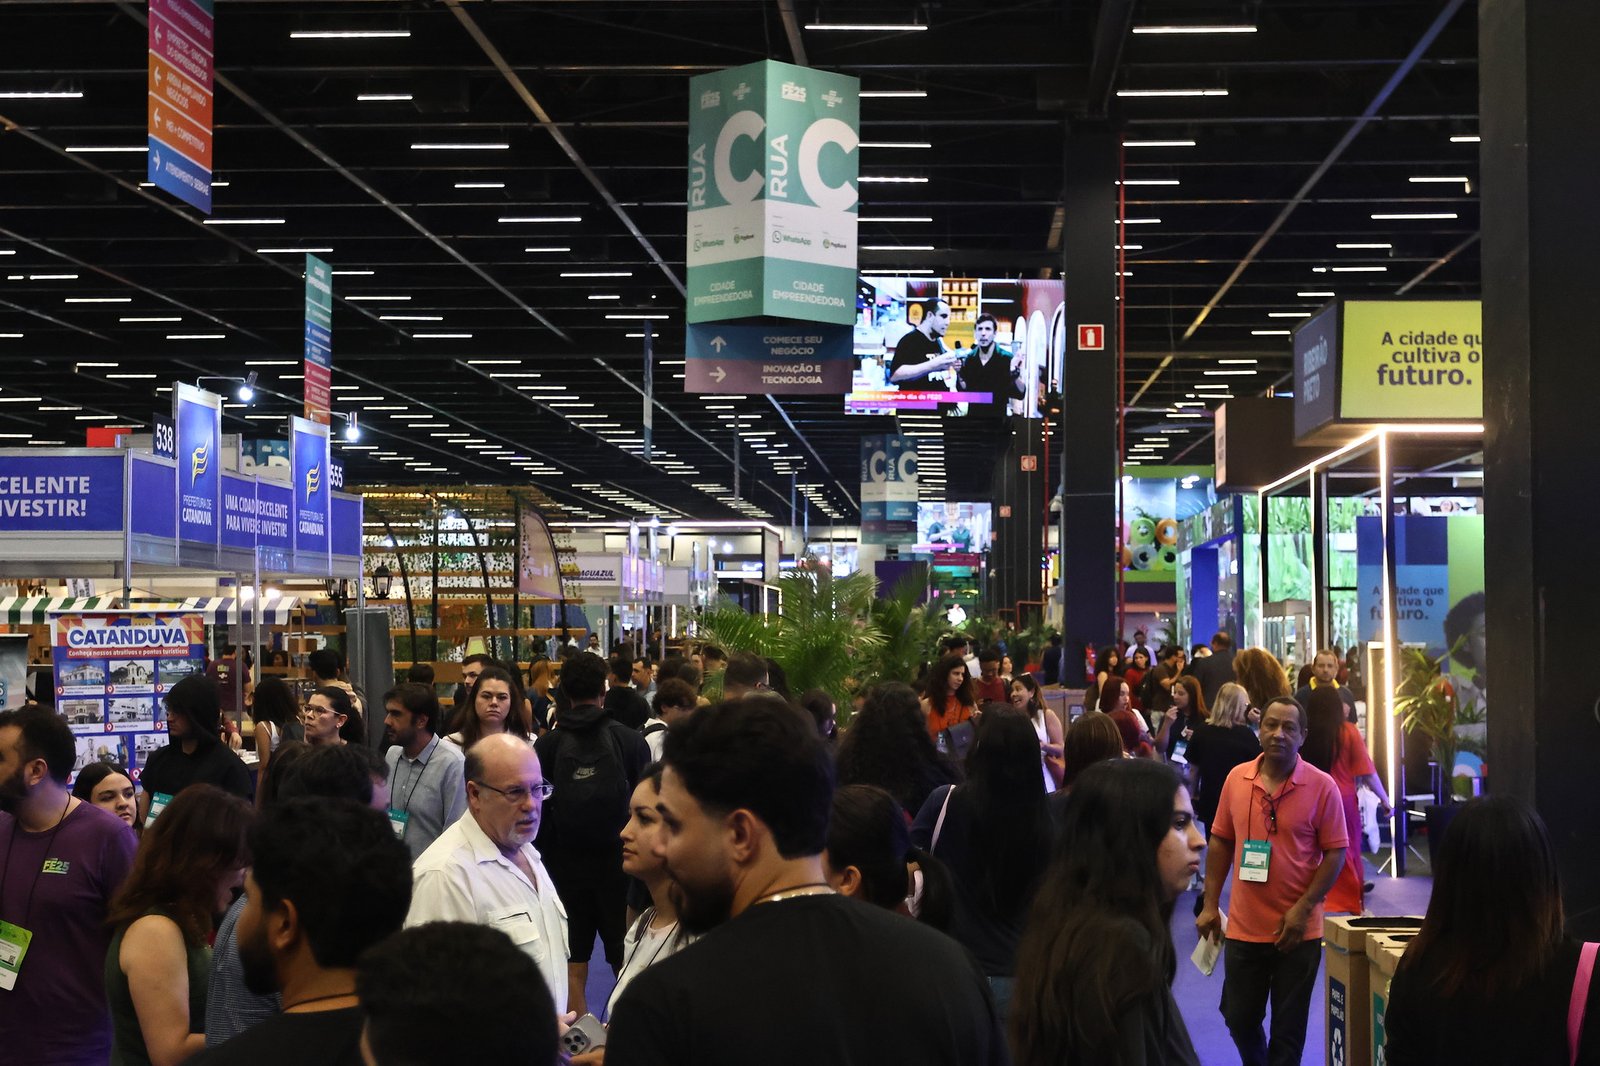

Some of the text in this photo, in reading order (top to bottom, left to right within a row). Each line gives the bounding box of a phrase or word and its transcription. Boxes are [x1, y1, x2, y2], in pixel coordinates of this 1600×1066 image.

[692, 110, 766, 208] RUA C
[770, 118, 860, 212] RUA C
[783, 234, 812, 246] WhatsApp
[710, 280, 736, 292] CIDADE
[793, 280, 825, 293] CIDADE
[694, 290, 753, 306] EMPREENDEDORA
[772, 290, 846, 308] EMPREENDEDORA
[763, 336, 823, 344] COMECE SEU
[1382, 332, 1394, 346] A
[1399, 331, 1458, 346] cidade
[771, 346, 814, 355] NEGÓCIO
[1392, 347, 1480, 364] cultiva o
[763, 363, 813, 374] INOVAÇÃO
[1377, 364, 1472, 386] futuro.
[762, 376, 822, 384] TECNOLOGIA
[1304, 373, 1320, 405] PRETO
[156, 423, 173, 453] 538
[870, 450, 887, 482] C
[898, 451, 918, 483] C
[330, 464, 343, 488] 555
[0, 499, 86, 517] VESTIR!
[183, 494, 205, 508] PREFEITURA
[225, 494, 239, 511] UMA
[260, 500, 288, 519] EXCELENTE
[183, 508, 212, 526] CATANDUVA
[226, 514, 240, 531] PARA
[262, 520, 288, 538] INVESTIR!
[299, 520, 324, 536] CATANDUVA
[1372, 586, 1380, 595] A
[1423, 587, 1444, 596] que
[1379, 597, 1434, 606] ctiva o
[1370, 605, 1429, 620] fuuro.
[70, 628, 186, 645] CATANDUVA
[43, 860, 70, 872] FE25
